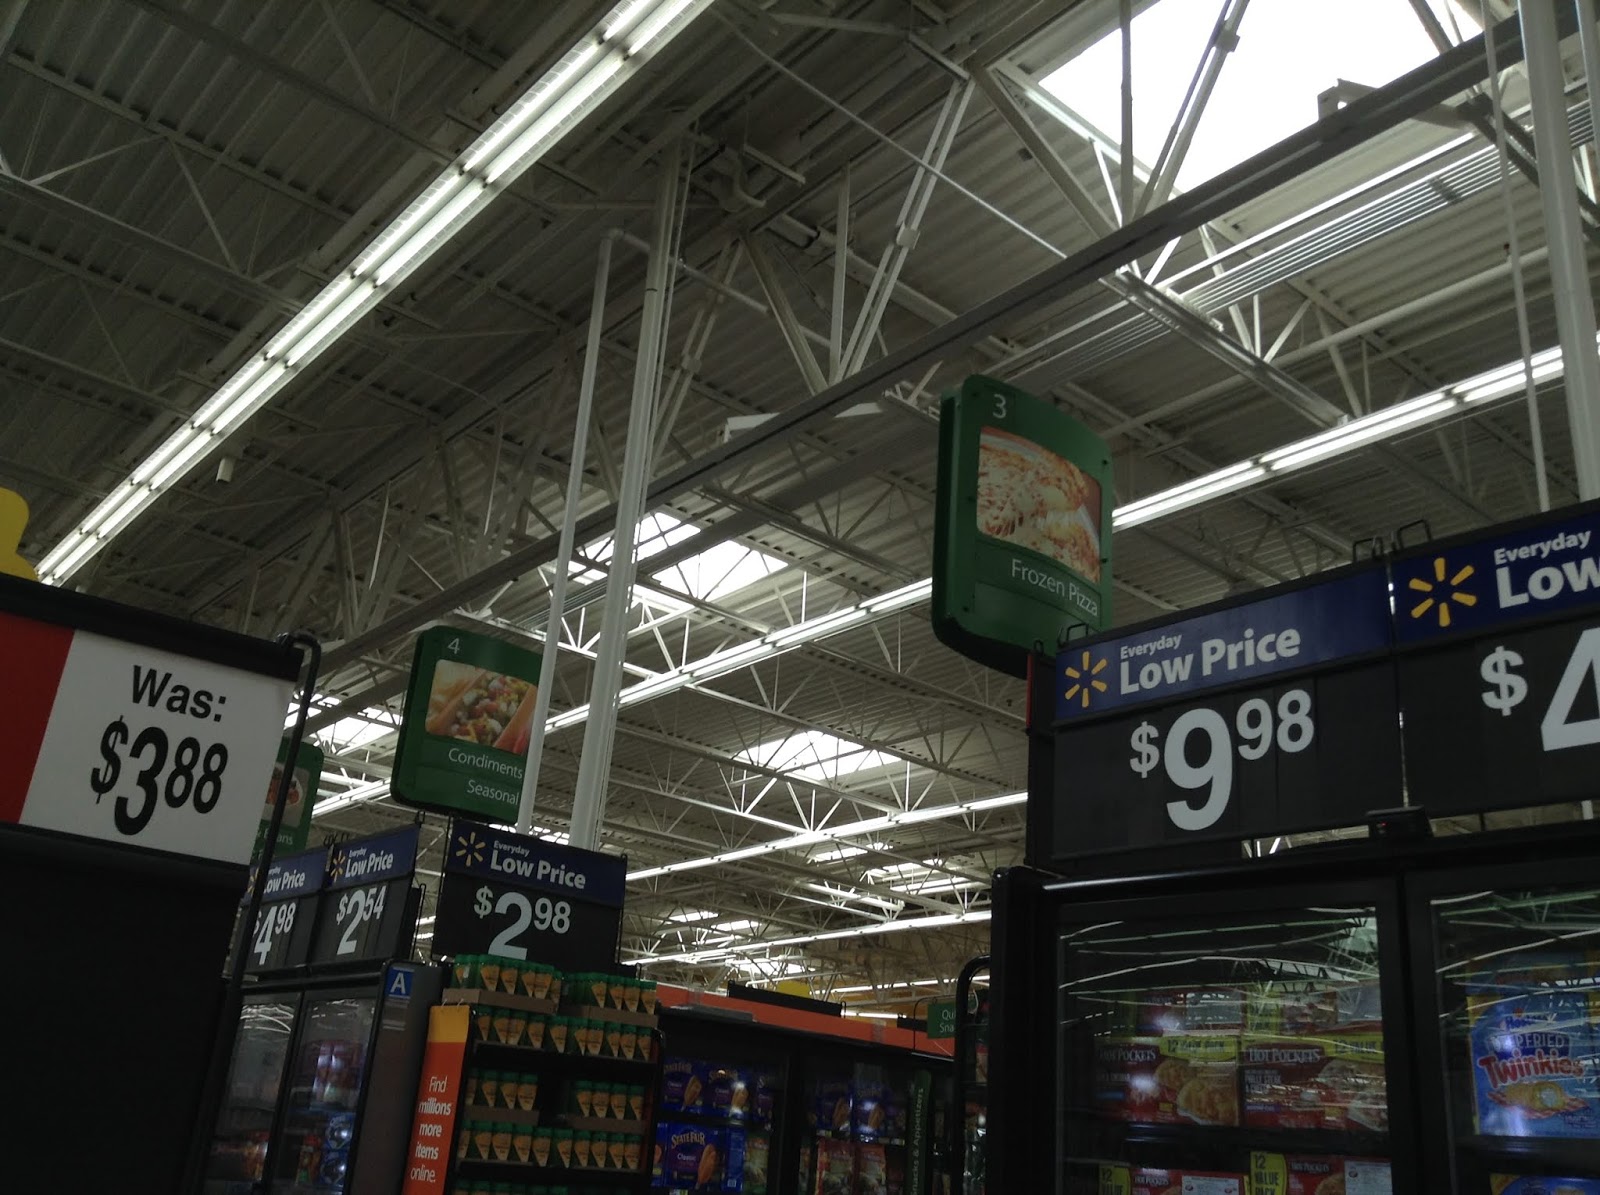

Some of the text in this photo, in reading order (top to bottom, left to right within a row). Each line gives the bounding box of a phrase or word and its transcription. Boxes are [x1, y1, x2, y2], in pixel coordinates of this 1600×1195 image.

[992, 394, 1007, 419] 3
[1494, 530, 1592, 565] Everyday
[1011, 558, 1098, 617] Frozen Pizza
[1496, 556, 1600, 609] Low
[447, 637, 461, 654] 4
[1120, 634, 1182, 659] Everyday
[1120, 628, 1301, 696] Low Price
[132, 665, 227, 722] Was:
[448, 748, 523, 779] Condiments
[466, 780, 520, 806] Seasonal
[493, 840, 530, 857] Everyday
[344, 850, 394, 879] Low Price
[490, 849, 586, 890] Low Price
[281, 869, 306, 891] Price
[390, 972, 406, 995] A
[1478, 1048, 1586, 1089] Twinkies
[428, 1076, 447, 1094] Find
[418, 1098, 451, 1116] millions
[419, 1123, 442, 1138] more
[415, 1147, 439, 1160] items
[1255, 1154, 1266, 1169] 12
[1255, 1171, 1280, 1187] VALUE
